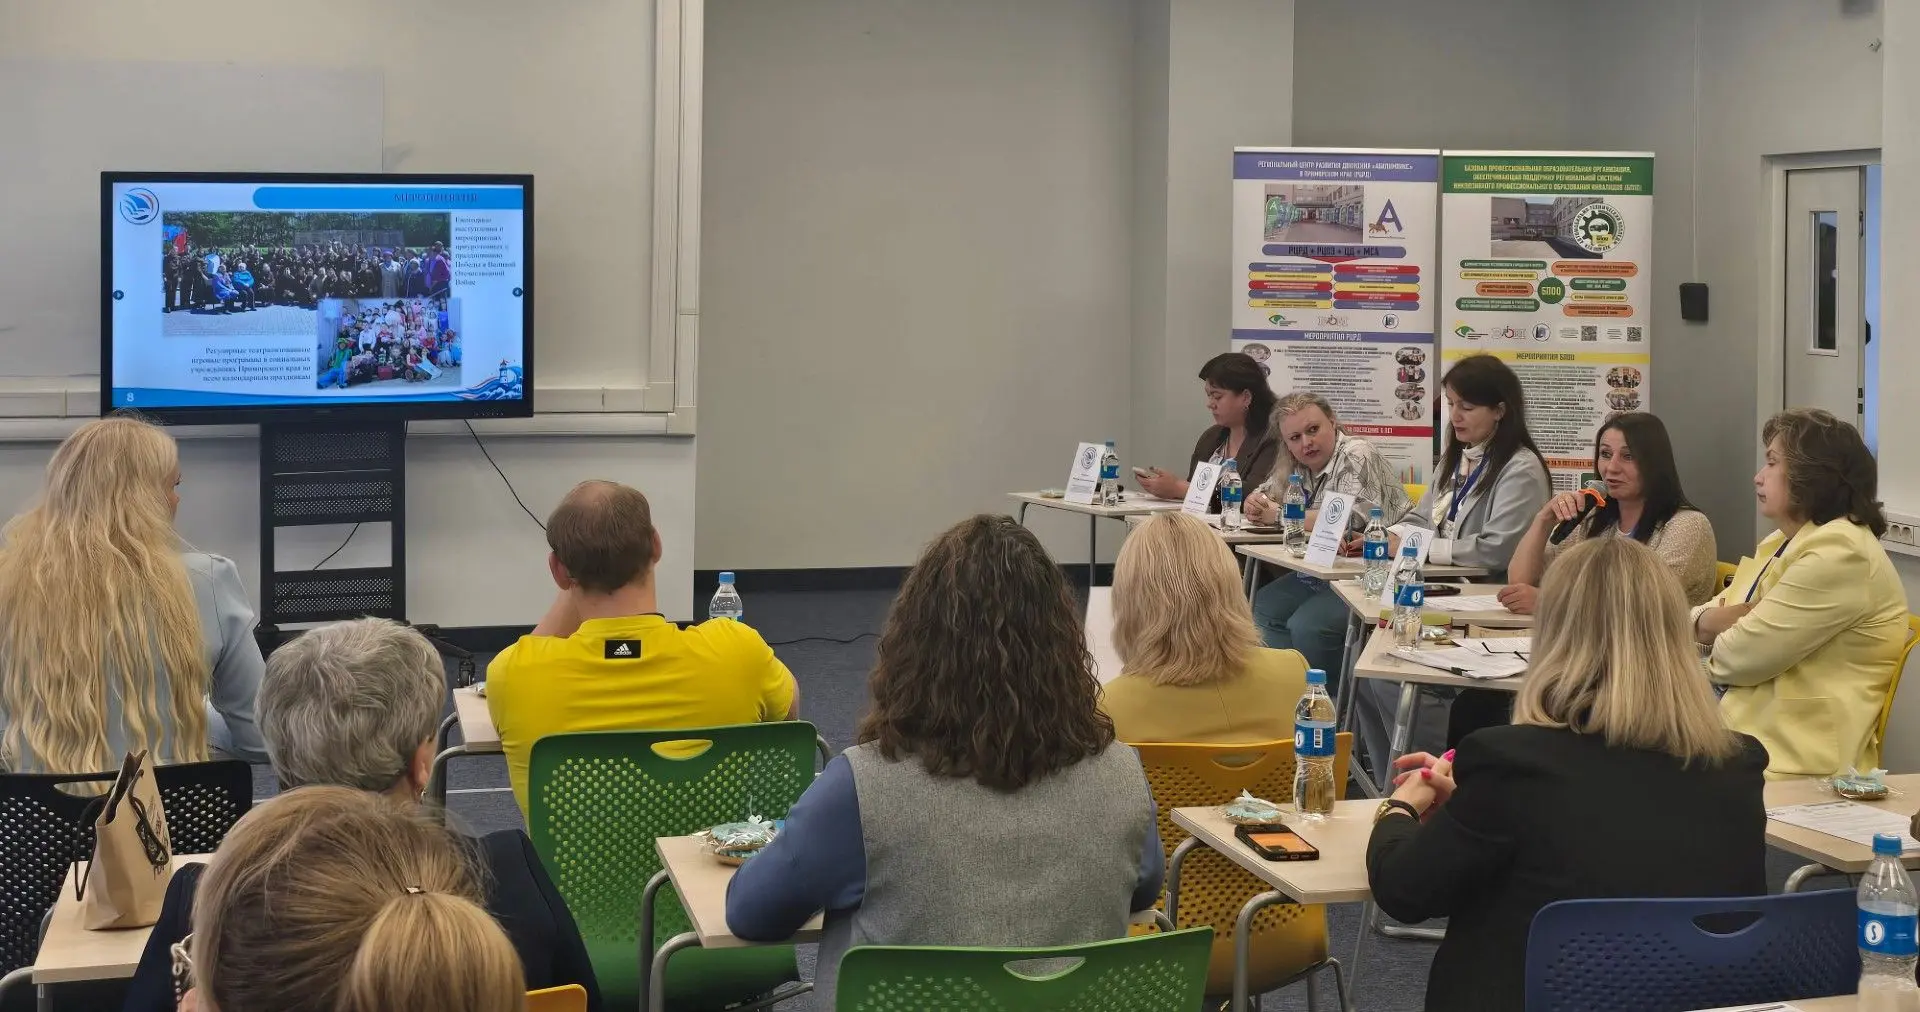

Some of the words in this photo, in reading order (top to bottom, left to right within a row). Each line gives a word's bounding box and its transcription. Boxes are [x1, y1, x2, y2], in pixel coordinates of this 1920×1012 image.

[1464, 164, 1488, 172] БАЗОВАЯ
[1543, 165, 1592, 173] ОБРАЗОВАТЕЛЬНАЯ
[1553, 183, 1591, 191] ОБРАЗОВАНИЯ
[1541, 286, 1561, 296] БПОО
[1304, 331, 1346, 341] МЕРОПРИЯТИЯ
[1516, 352, 1559, 361] МЕРОПРИЯТИЯ
[126, 392, 135, 402] 8
